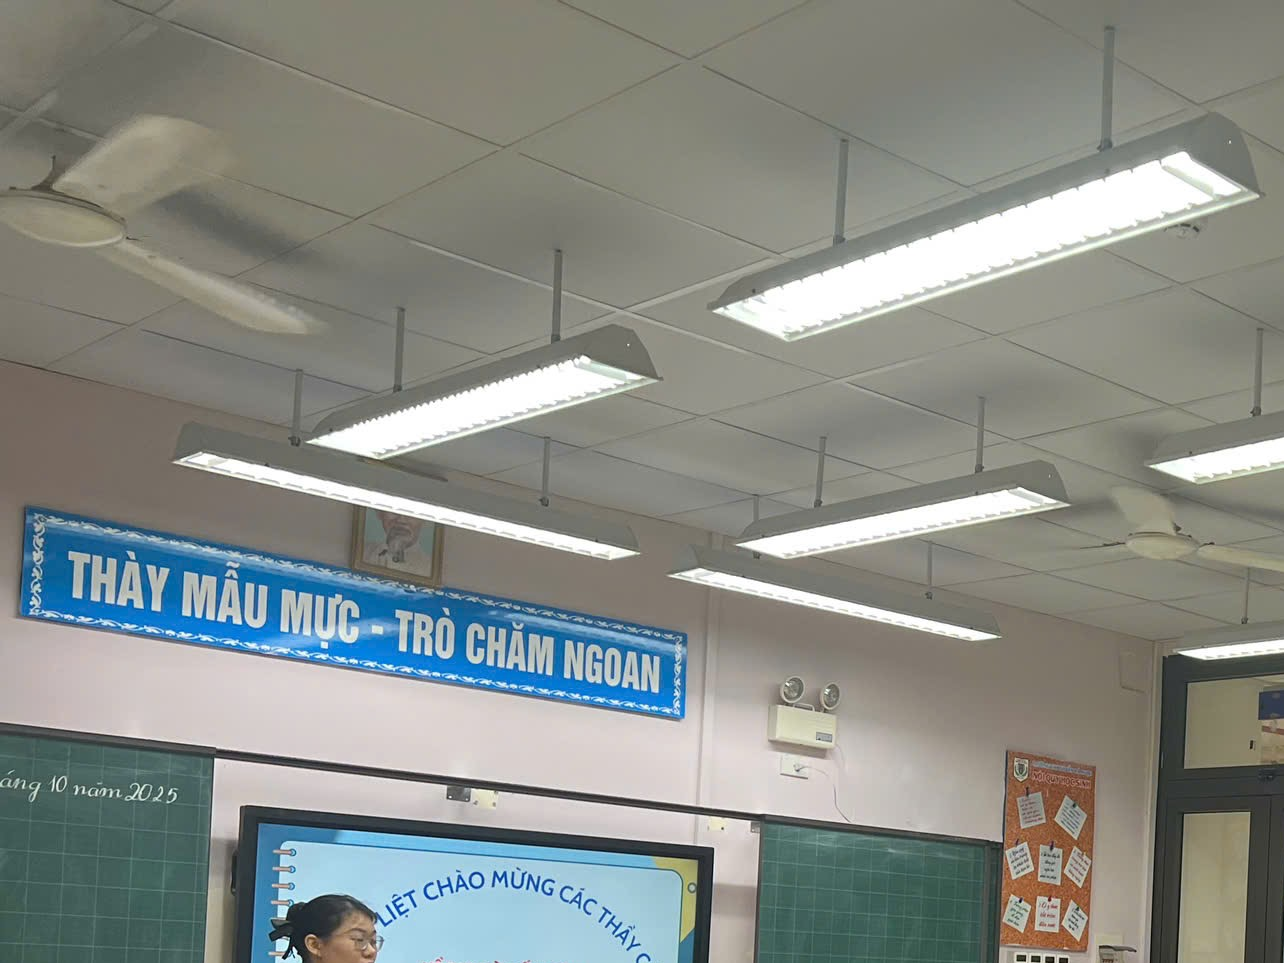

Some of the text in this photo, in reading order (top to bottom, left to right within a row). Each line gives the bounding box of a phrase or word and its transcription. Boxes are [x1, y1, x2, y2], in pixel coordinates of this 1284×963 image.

[67, 550, 170, 612] THÀY
[181, 561, 269, 629] MẪU
[279, 588, 361, 649] MỰC
[395, 607, 455, 660] TRÒ
[465, 621, 555, 676] CHĂM
[563, 639, 660, 694] NGOAN
[49, 775, 68, 793] 10
[73, 781, 122, 798] năm
[124, 782, 179, 804] 2025
[376, 889, 417, 927] LIỆT
[423, 869, 485, 900] CHÀO
[491, 867, 555, 896] MỪNG
[559, 888, 597, 915] CÁC
[598, 906, 641, 951] THẦY
